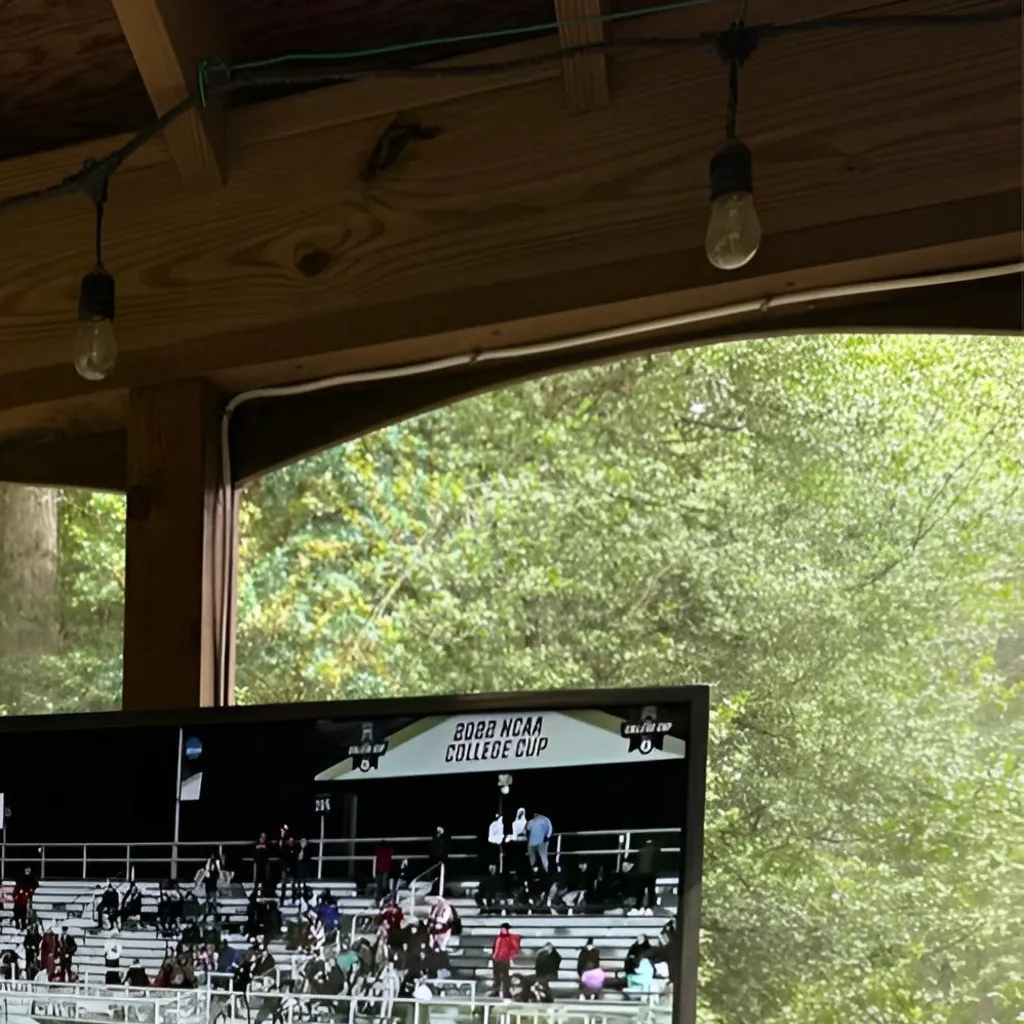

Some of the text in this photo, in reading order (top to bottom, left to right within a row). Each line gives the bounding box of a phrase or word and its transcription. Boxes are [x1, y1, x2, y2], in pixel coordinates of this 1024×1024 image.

[500, 716, 543, 737] NCAA
[445, 737, 548, 762] COLLEGE CUP
